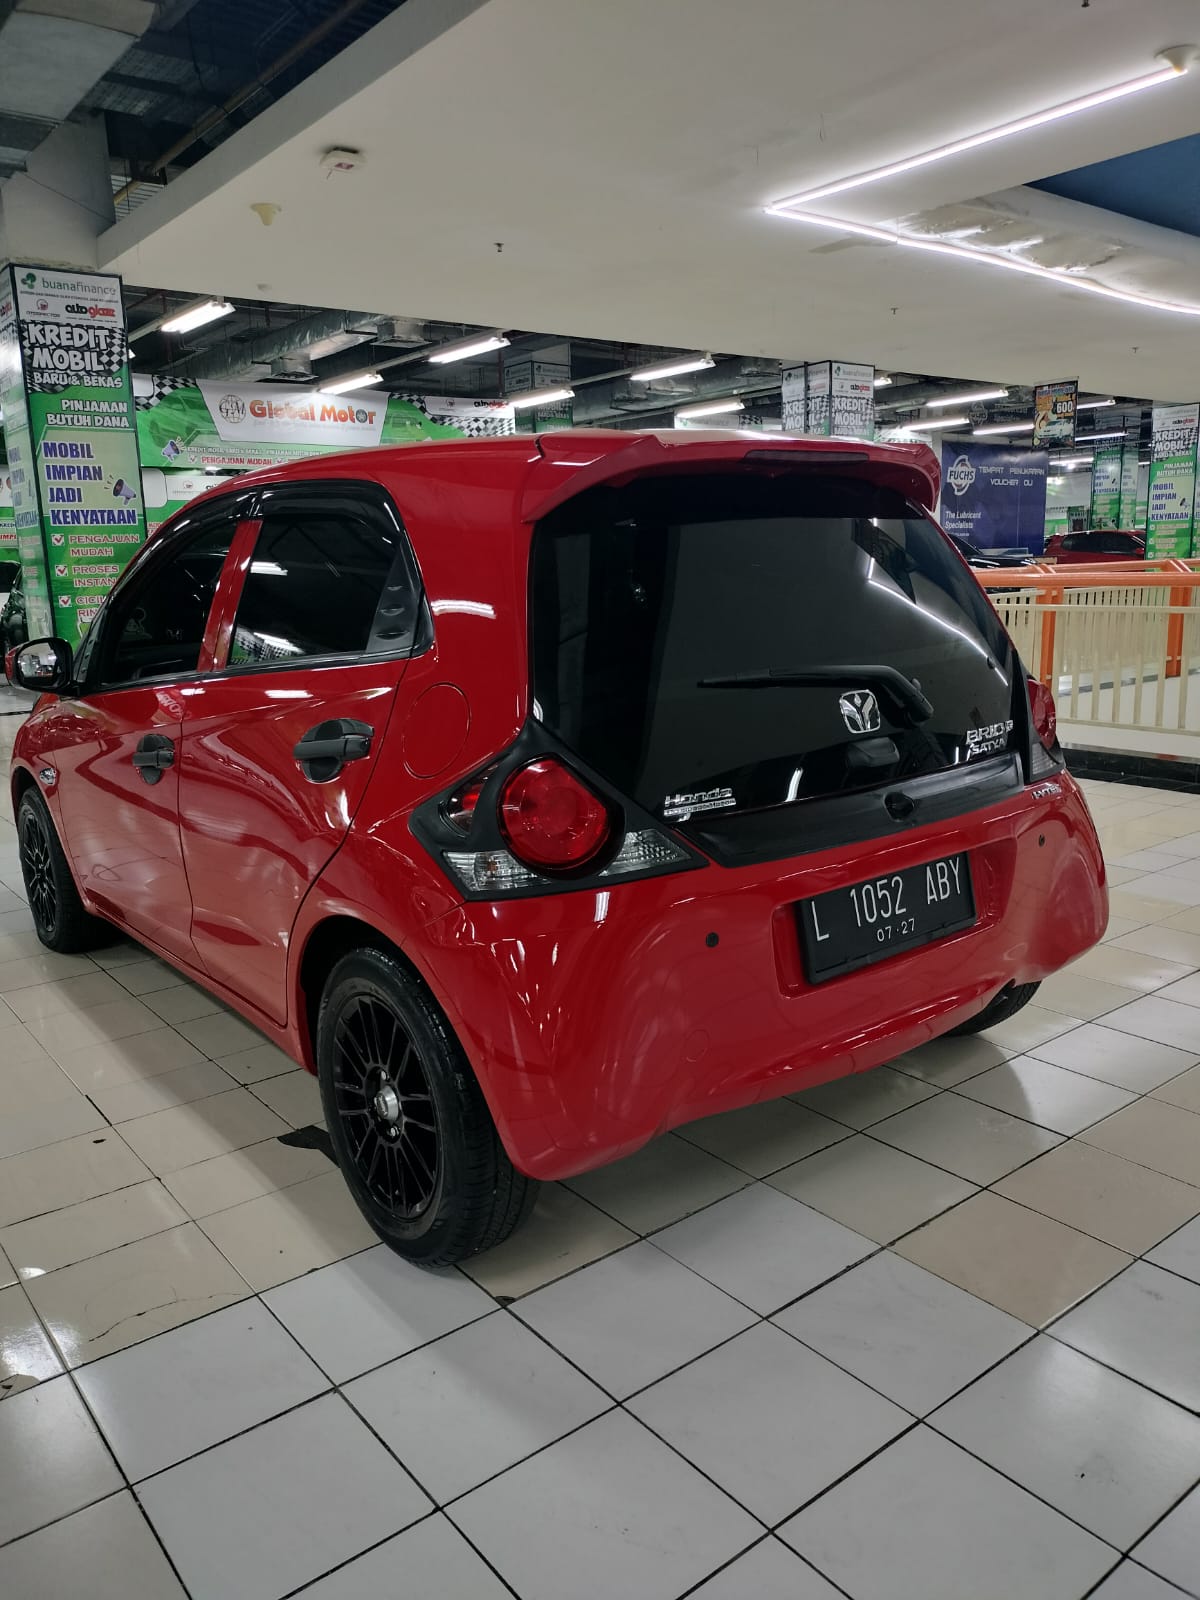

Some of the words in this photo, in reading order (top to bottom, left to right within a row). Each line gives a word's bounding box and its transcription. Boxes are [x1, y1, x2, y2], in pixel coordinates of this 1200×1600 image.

[28, 323, 110, 350] KREDIT
[32, 347, 105, 371] MOBIL
[33, 372, 68, 385] BARU
[71, 375, 80, 385] &
[84, 375, 123, 388] BEKAS
[61, 400, 128, 413] PINJAMAN
[834, 397, 868, 411] KREDIT
[1056, 401, 1073, 414] 600
[47, 414, 92, 425] BUTUH
[94, 416, 129, 427] DANA
[834, 412, 863, 425] MOBIL
[1155, 429, 1191, 441] KREDIT
[43, 442, 94, 458] MOBIL
[1154, 440, 1185, 452] MOBIL
[46, 465, 103, 480] IMPIAN
[948, 470, 974, 481] FUCHS
[990, 478, 1019, 487] VOUCHER
[49, 487, 83, 502] JADI
[51, 509, 137, 525] KENYATAAN
[945, 511, 956, 519] The
[69, 535, 139, 544] PENGAJUAN
[71, 548, 113, 556] MUDAH
[73, 566, 118, 574] PROSES
[970, 738, 1005, 756] SATYA
[665, 788, 732, 807] Honda
[811, 900, 830, 942] L
[850, 875, 907, 928] 1052
[925, 856, 962, 905] ABY
